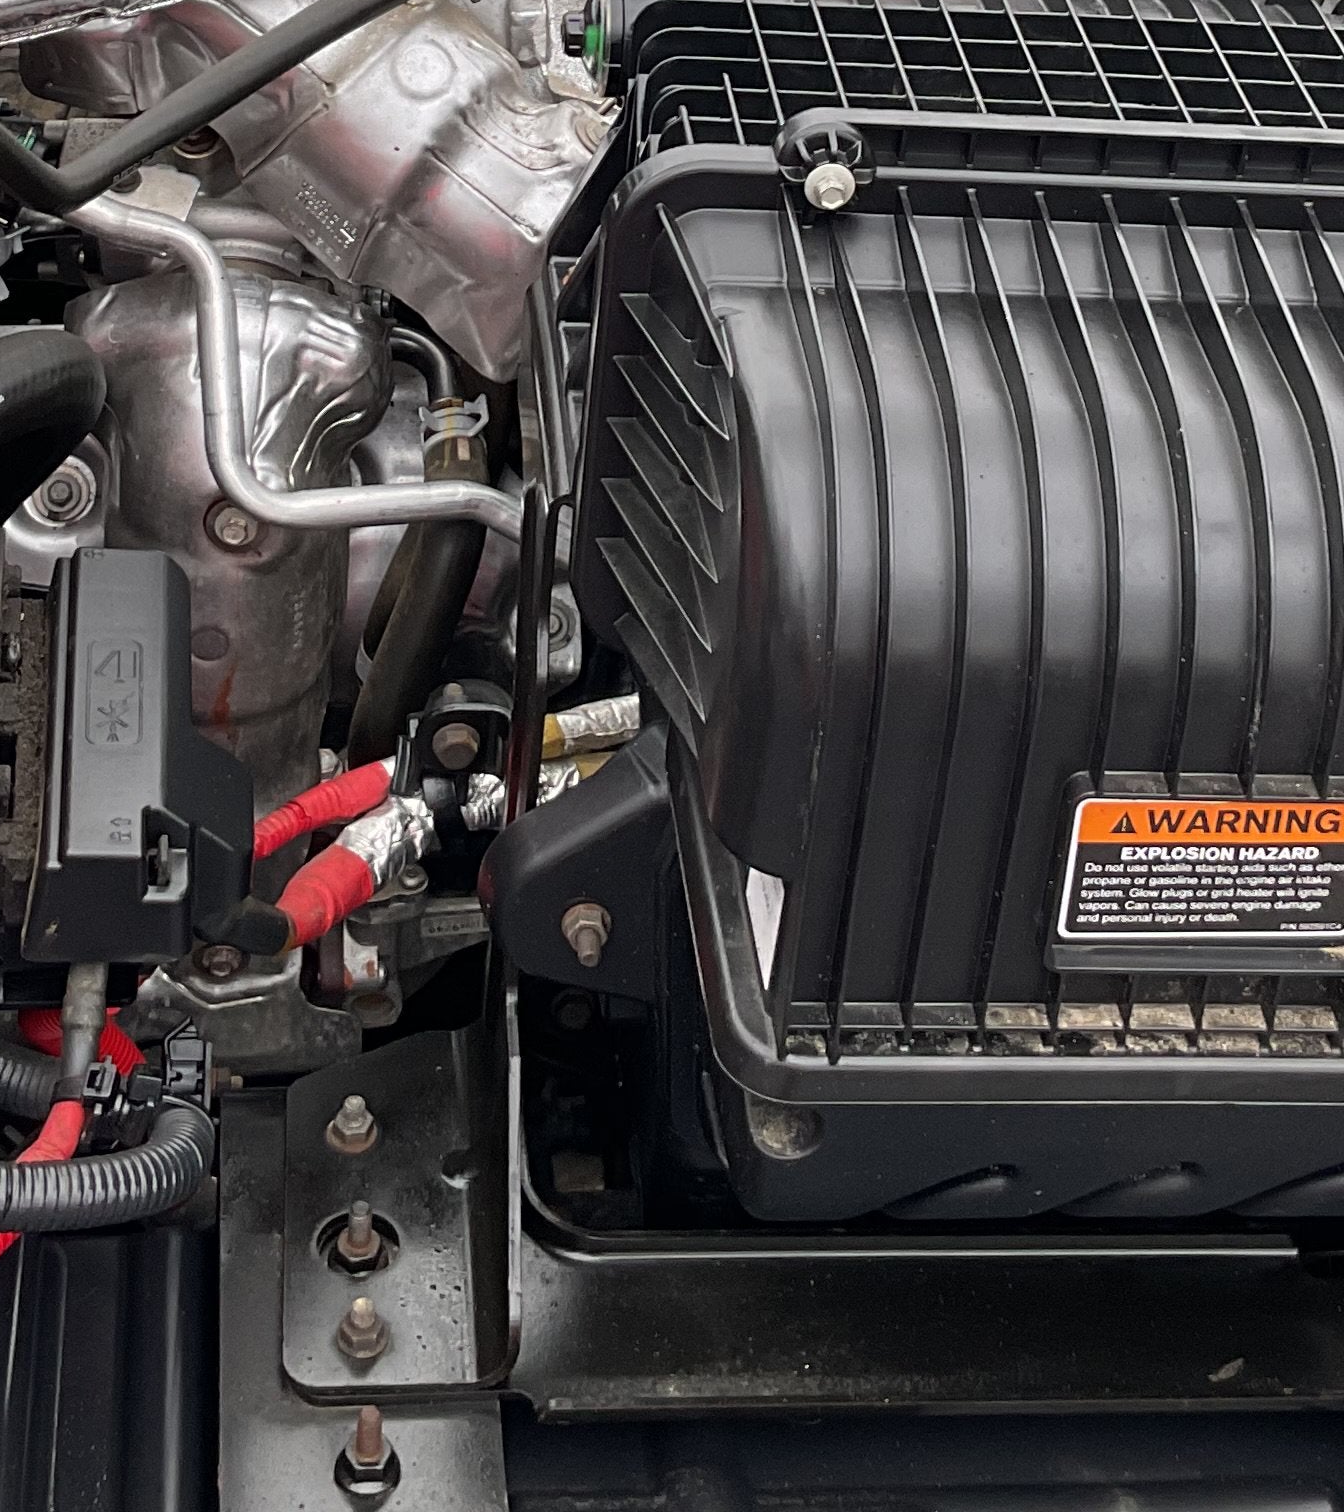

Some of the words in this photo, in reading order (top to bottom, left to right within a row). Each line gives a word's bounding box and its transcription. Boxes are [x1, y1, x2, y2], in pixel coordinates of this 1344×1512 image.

[1146, 808, 1342, 834] WARNING
[1120, 846, 1235, 861] EXPLOSION
[1238, 846, 1320, 861] HAZARD
[1084, 862, 1103, 873] Do
[1104, 863, 1124, 873] not
[1126, 864, 1149, 873] use
[1151, 862, 1193, 873] volatile
[1195, 863, 1239, 875] starting
[1268, 862, 1296, 872] such
[1298, 864, 1314, 872] as
[1082, 876, 1132, 886] propane
[1133, 876, 1147, 885] or
[1148, 874, 1199, 886] gasoline
[1201, 875, 1213, 885] in
[1214, 875, 1234, 885] the
[1236, 876, 1276, 886] engine
[1277, 875, 1295, 884] air
[1080, 888, 1126, 899] system.
[1128, 887, 1160, 897] Glow
[1161, 888, 1194, 899] plugs
[1196, 889, 1209, 897] or
[1236, 888, 1275, 897] heater
[1078, 902, 1120, 911] vapors.
[1124, 900, 1150, 910] Can
[1151, 902, 1187, 910] cause
[1189, 901, 1230, 910] severe
[1231, 900, 1272, 911] engine
[1273, 900, 1322, 911] damage
[1076, 913, 1100, 923] and
[1101, 913, 1153, 924] personal
[1154, 913, 1187, 924] injury
[1188, 914, 1202, 922] or
[1203, 912, 1239, 922] death.
